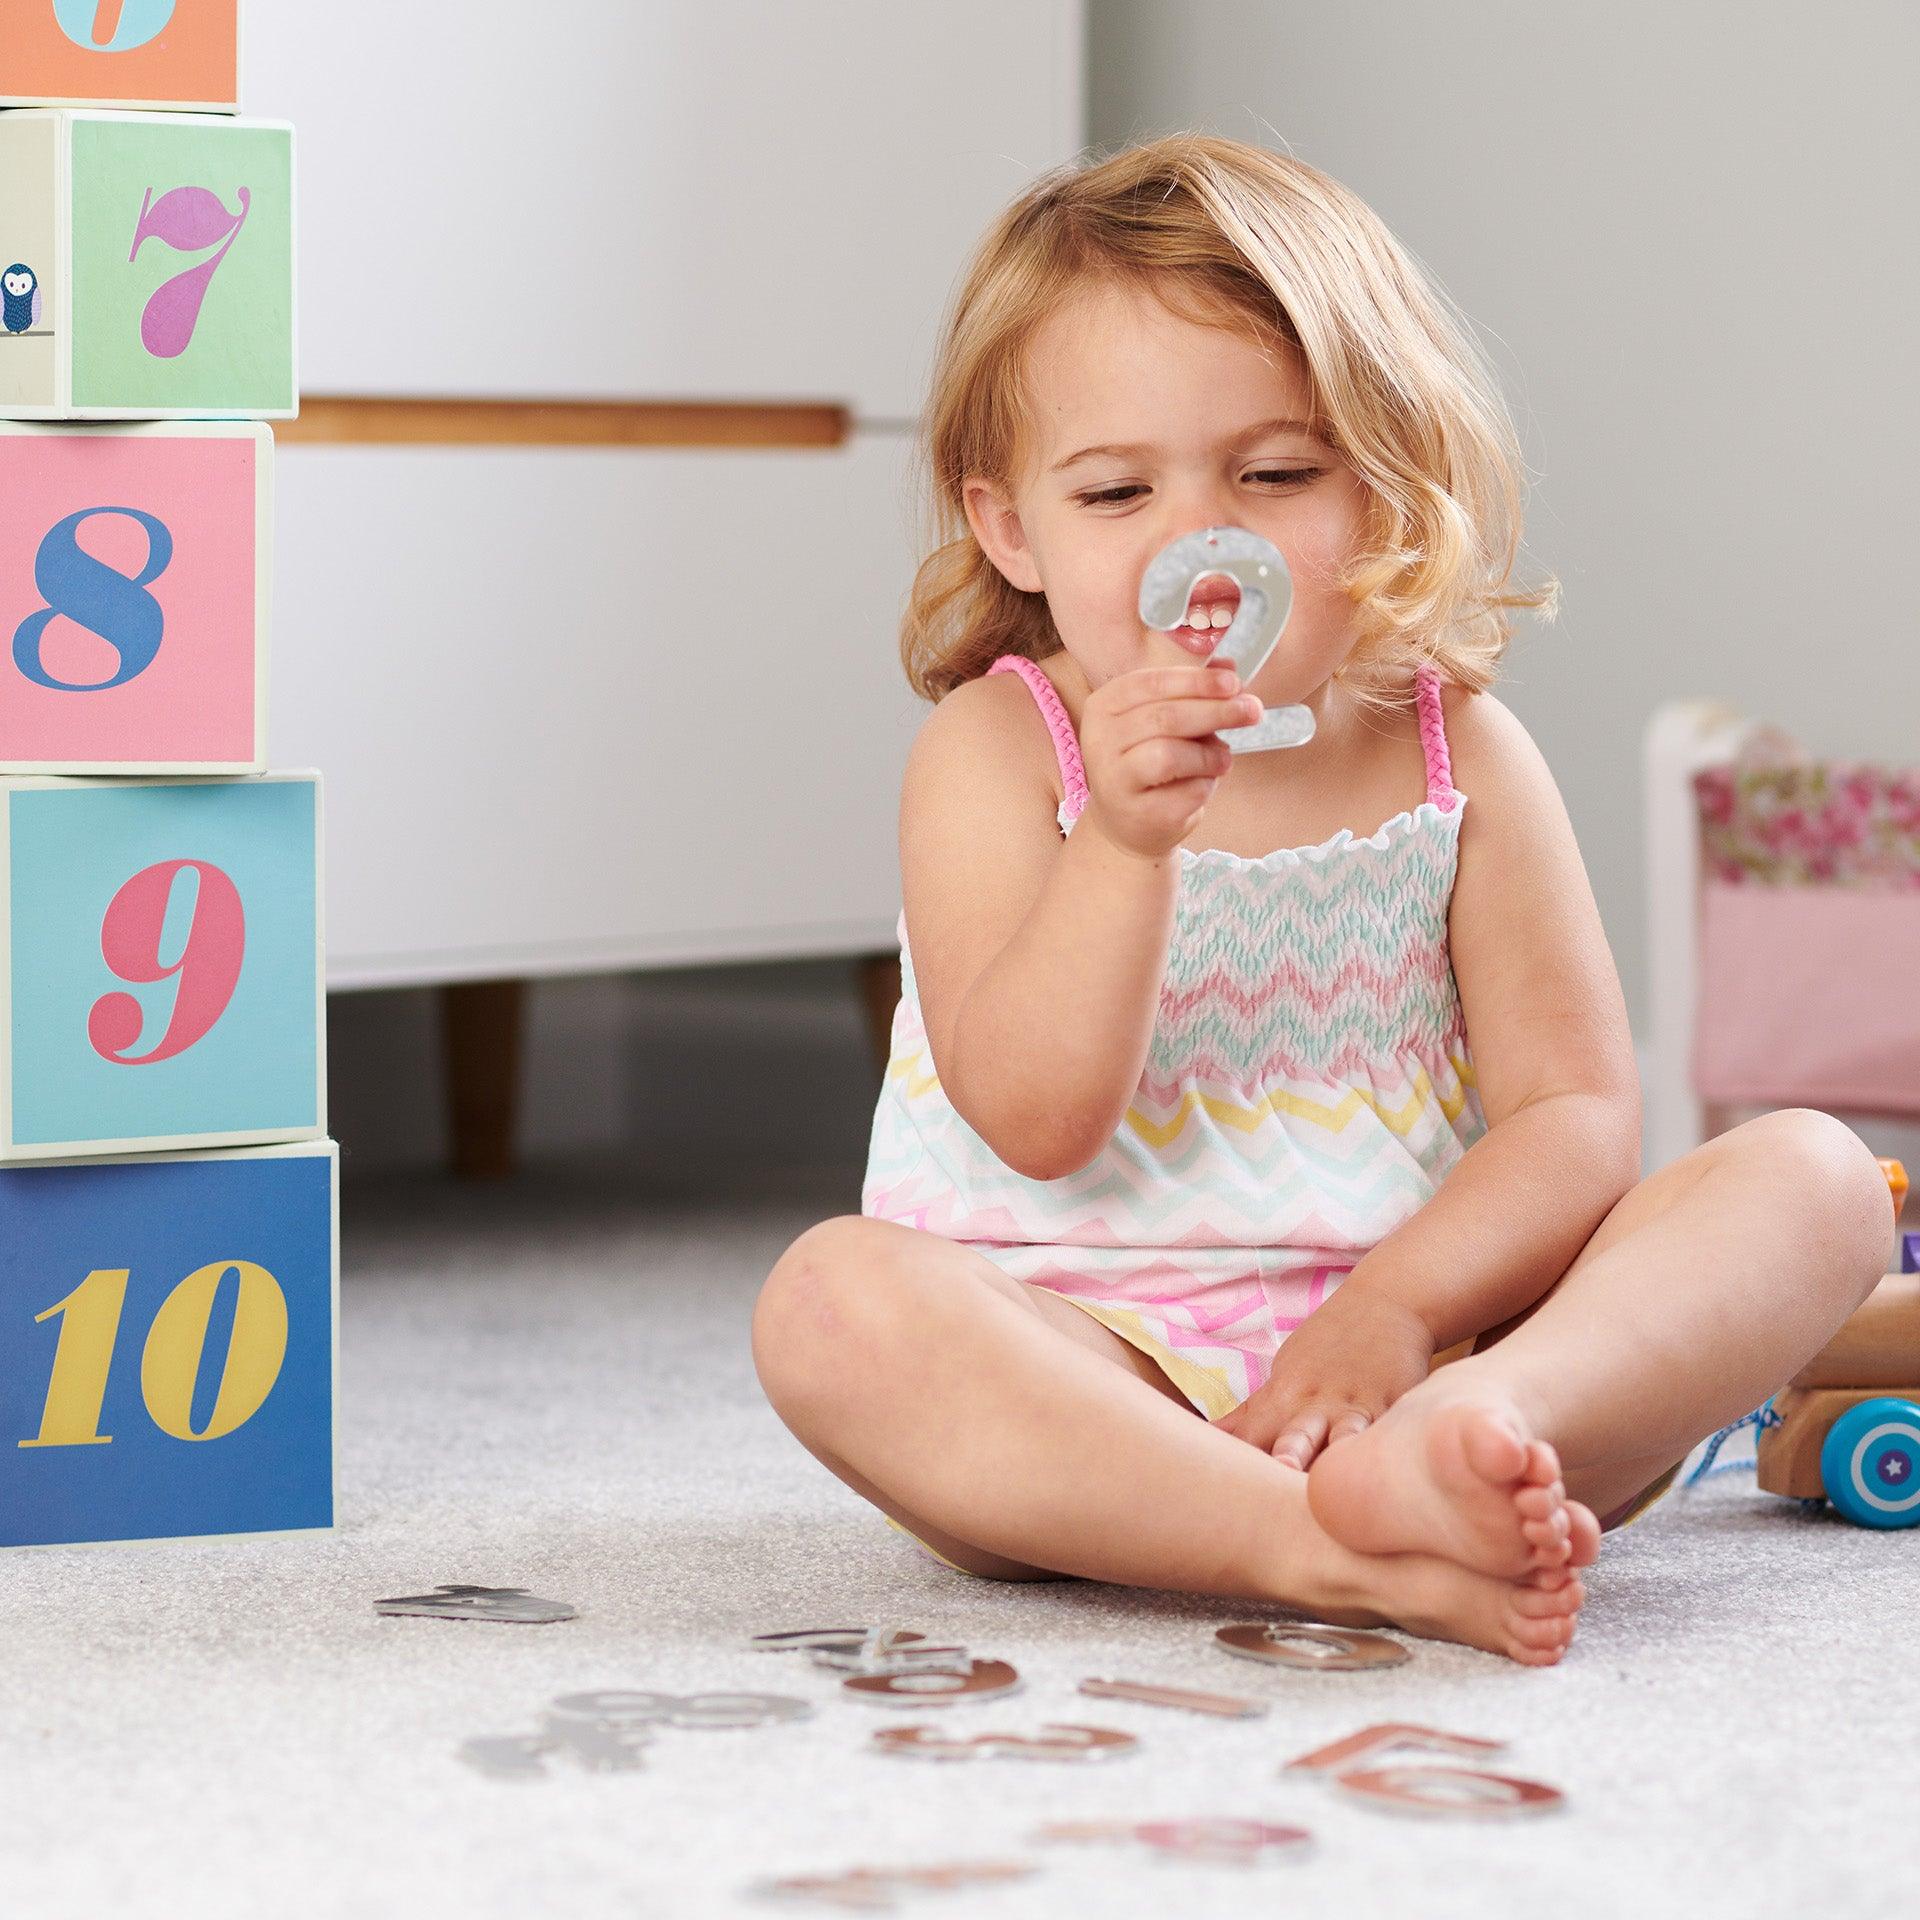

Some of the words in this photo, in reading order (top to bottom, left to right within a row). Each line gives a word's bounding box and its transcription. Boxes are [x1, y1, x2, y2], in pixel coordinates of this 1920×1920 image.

[128, 185, 252, 360] 7
[12, 506, 174, 693] 8
[1138, 526, 1317, 755] 2
[87, 858, 246, 1067] 9
[17, 1258, 290, 1449] 10
